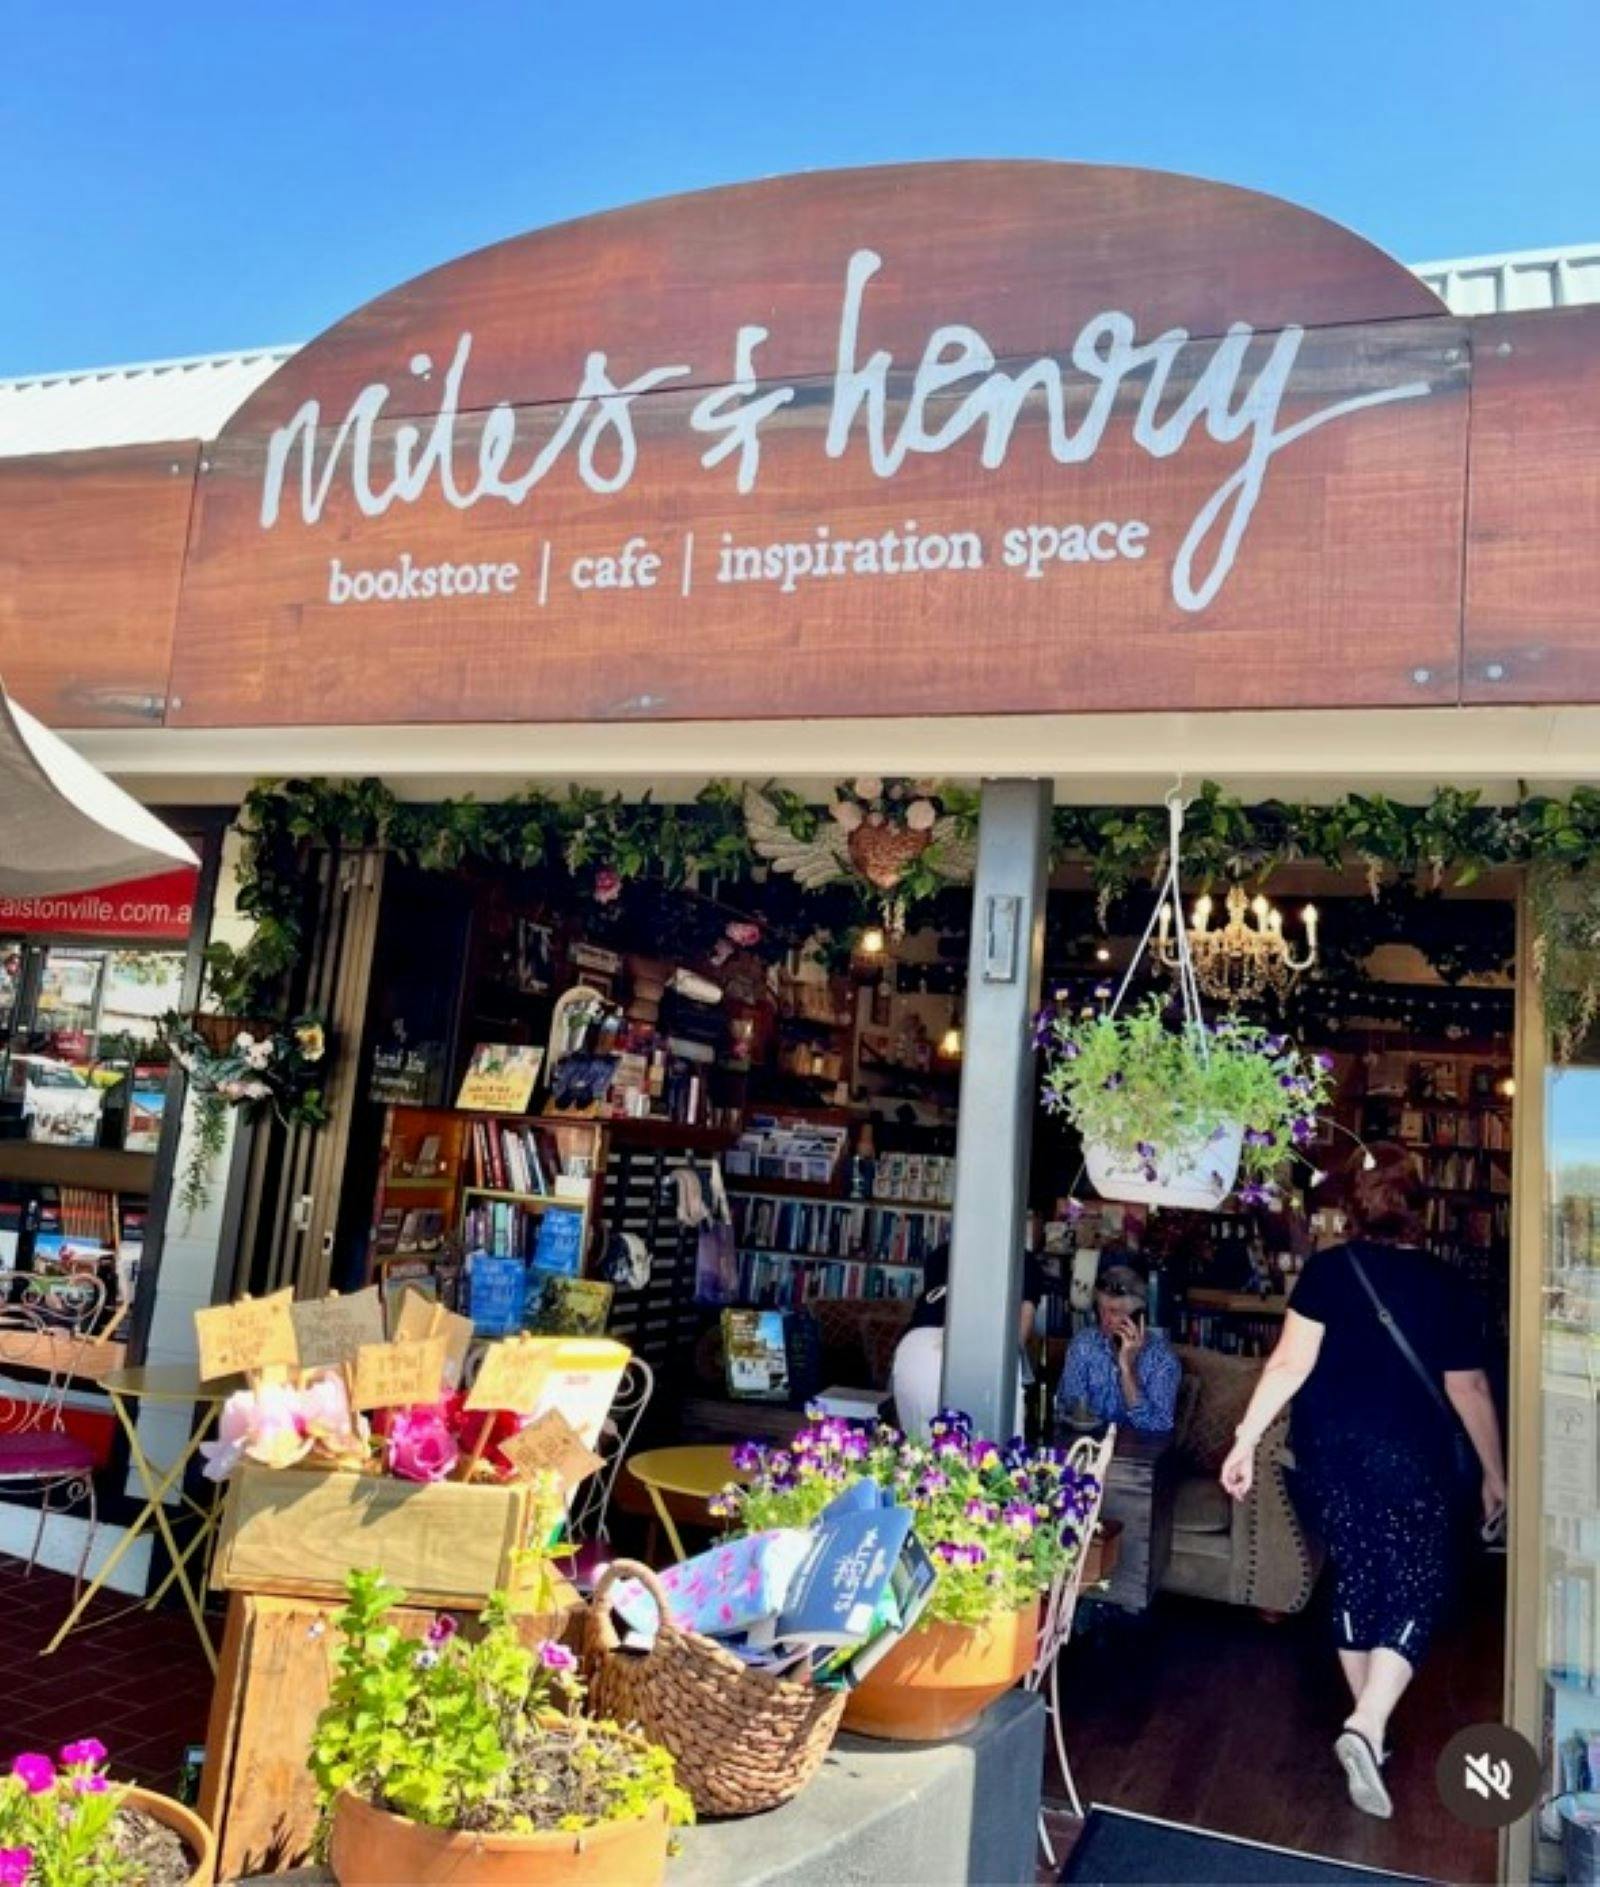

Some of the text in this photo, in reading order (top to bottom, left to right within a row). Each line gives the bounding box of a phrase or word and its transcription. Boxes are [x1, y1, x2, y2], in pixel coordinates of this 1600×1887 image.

[690, 326, 794, 494] &
[825, 248, 1432, 612] henry
[328, 554, 520, 605] bookstore
[570, 537, 662, 589] cafe
[717, 518, 984, 593] inspiration
[1002, 519, 1150, 580] space
